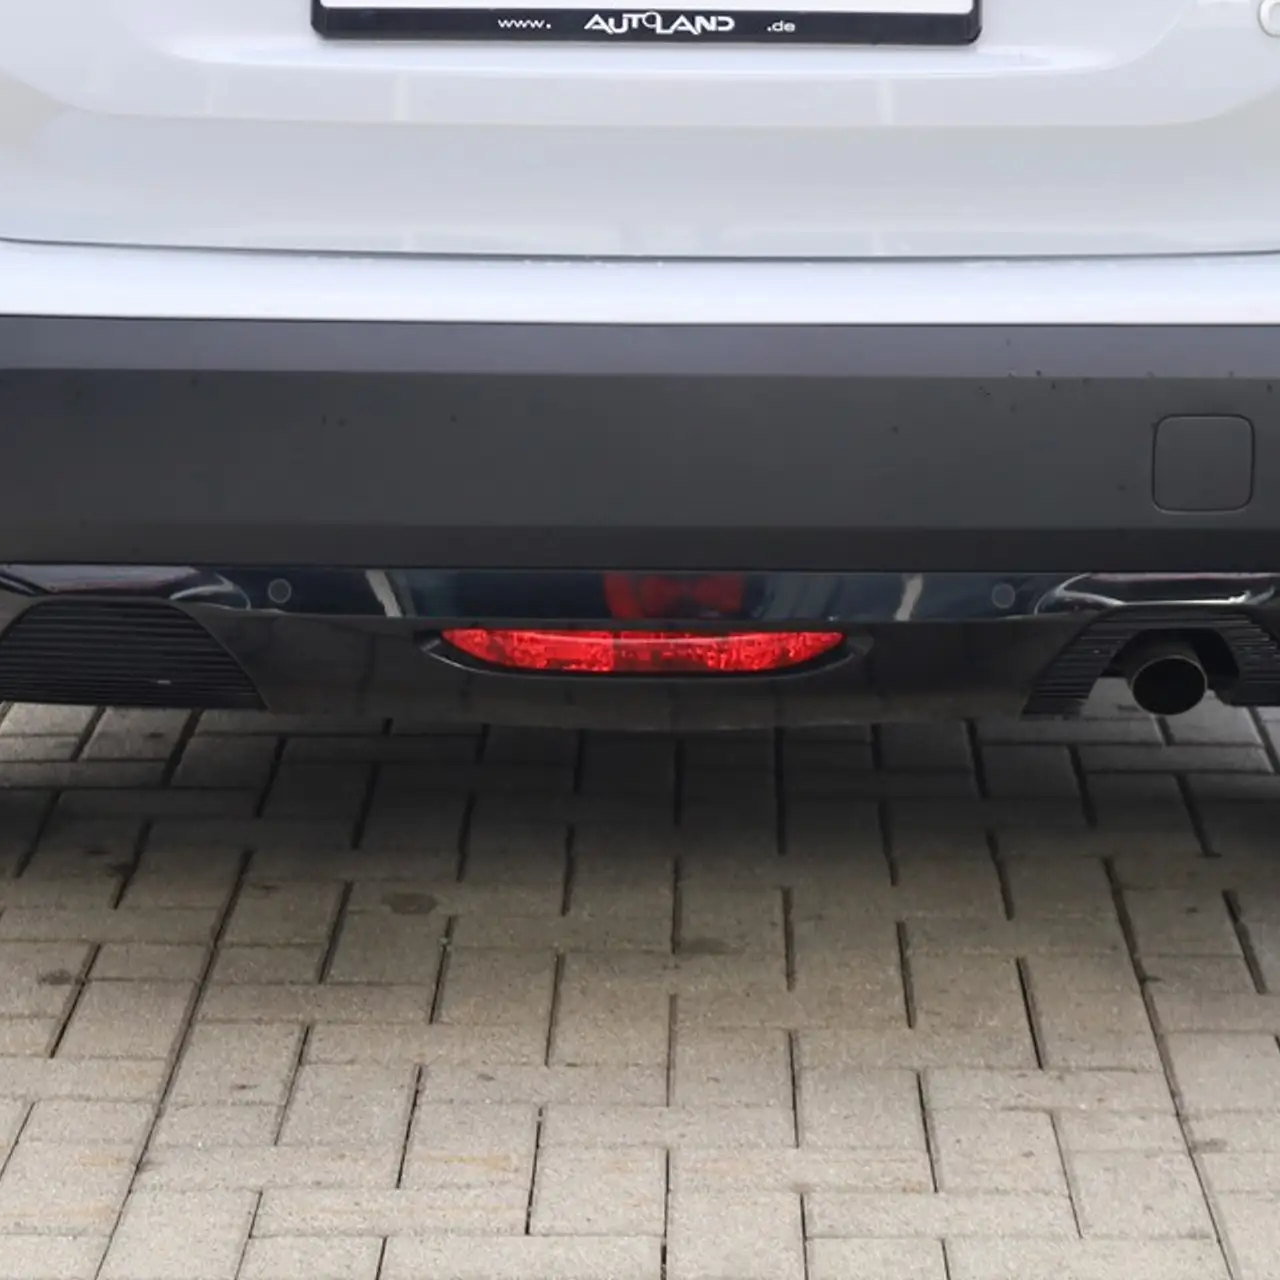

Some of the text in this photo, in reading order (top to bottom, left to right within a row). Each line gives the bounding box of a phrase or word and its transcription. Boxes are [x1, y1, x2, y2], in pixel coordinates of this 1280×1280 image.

[497, 10, 797, 36] www. AUTOLAND .de
